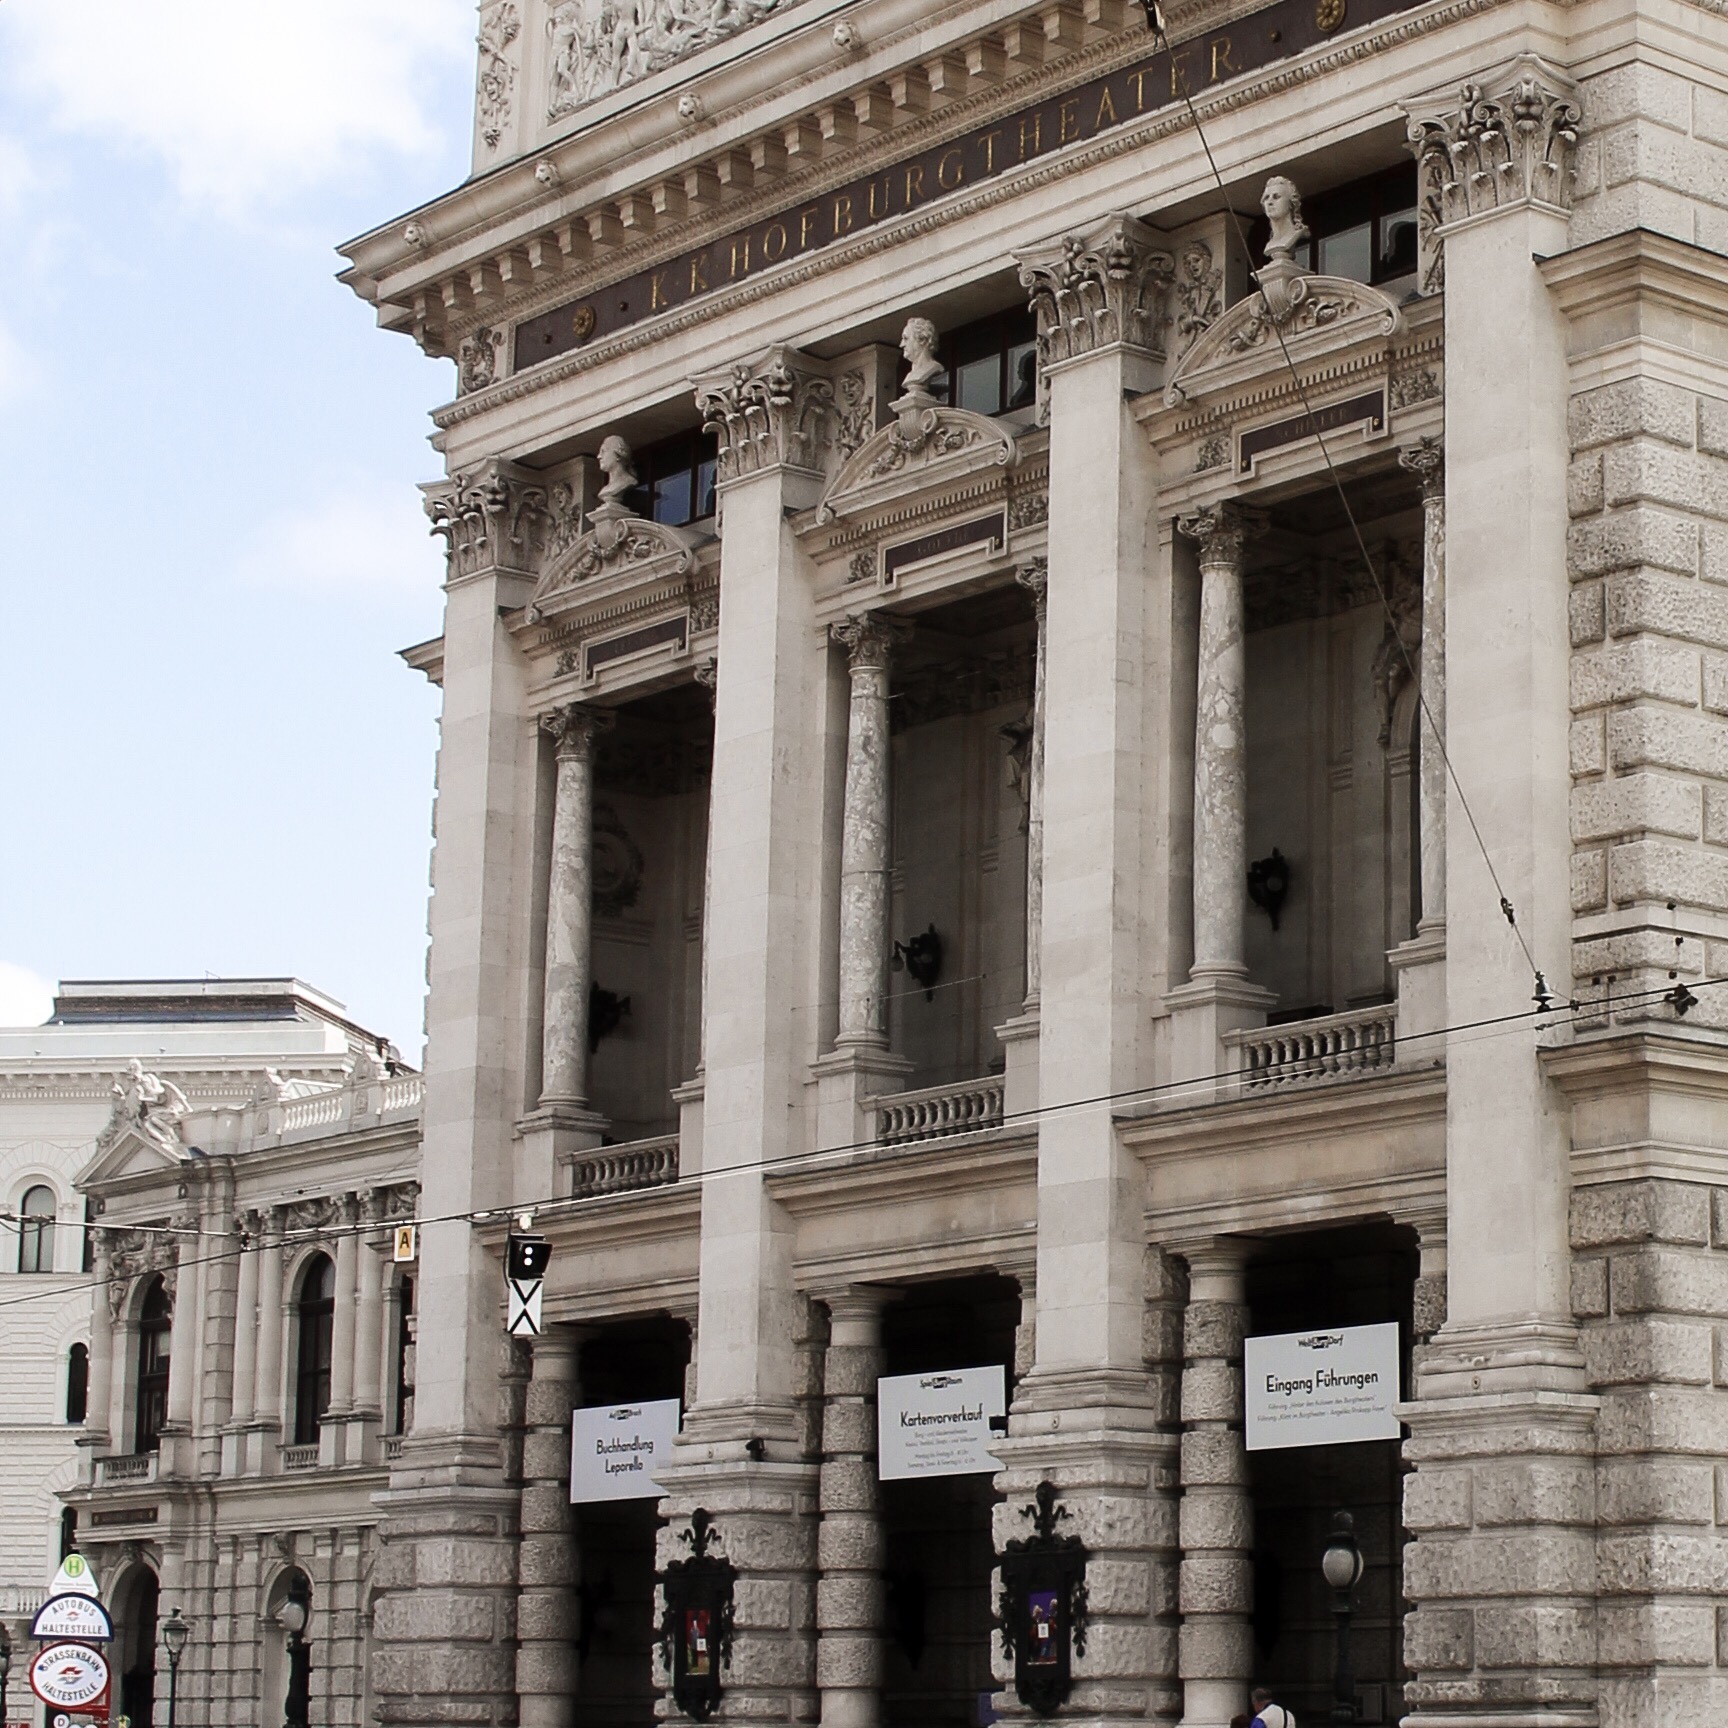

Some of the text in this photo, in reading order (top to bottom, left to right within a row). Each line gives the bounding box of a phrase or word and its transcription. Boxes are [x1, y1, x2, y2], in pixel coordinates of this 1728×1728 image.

[399, 1231, 410, 1249] A
[1266, 1368, 1379, 1396] Eingang Führungen
[900, 1403, 983, 1427] Kartenvorverkauf
[596, 1435, 654, 1454] Buchhandlung
[605, 1455, 643, 1477] Leporello
[69, 1560, 79, 1572] H
[51, 1599, 97, 1617] AUTOBUS
[42, 1623, 103, 1635] HALTESTELLE
[41, 1649, 101, 1673] STRASSENBAHN
[42, 1682, 99, 1702] HALTESTELLE
[58, 1718, 65, 1727] D
